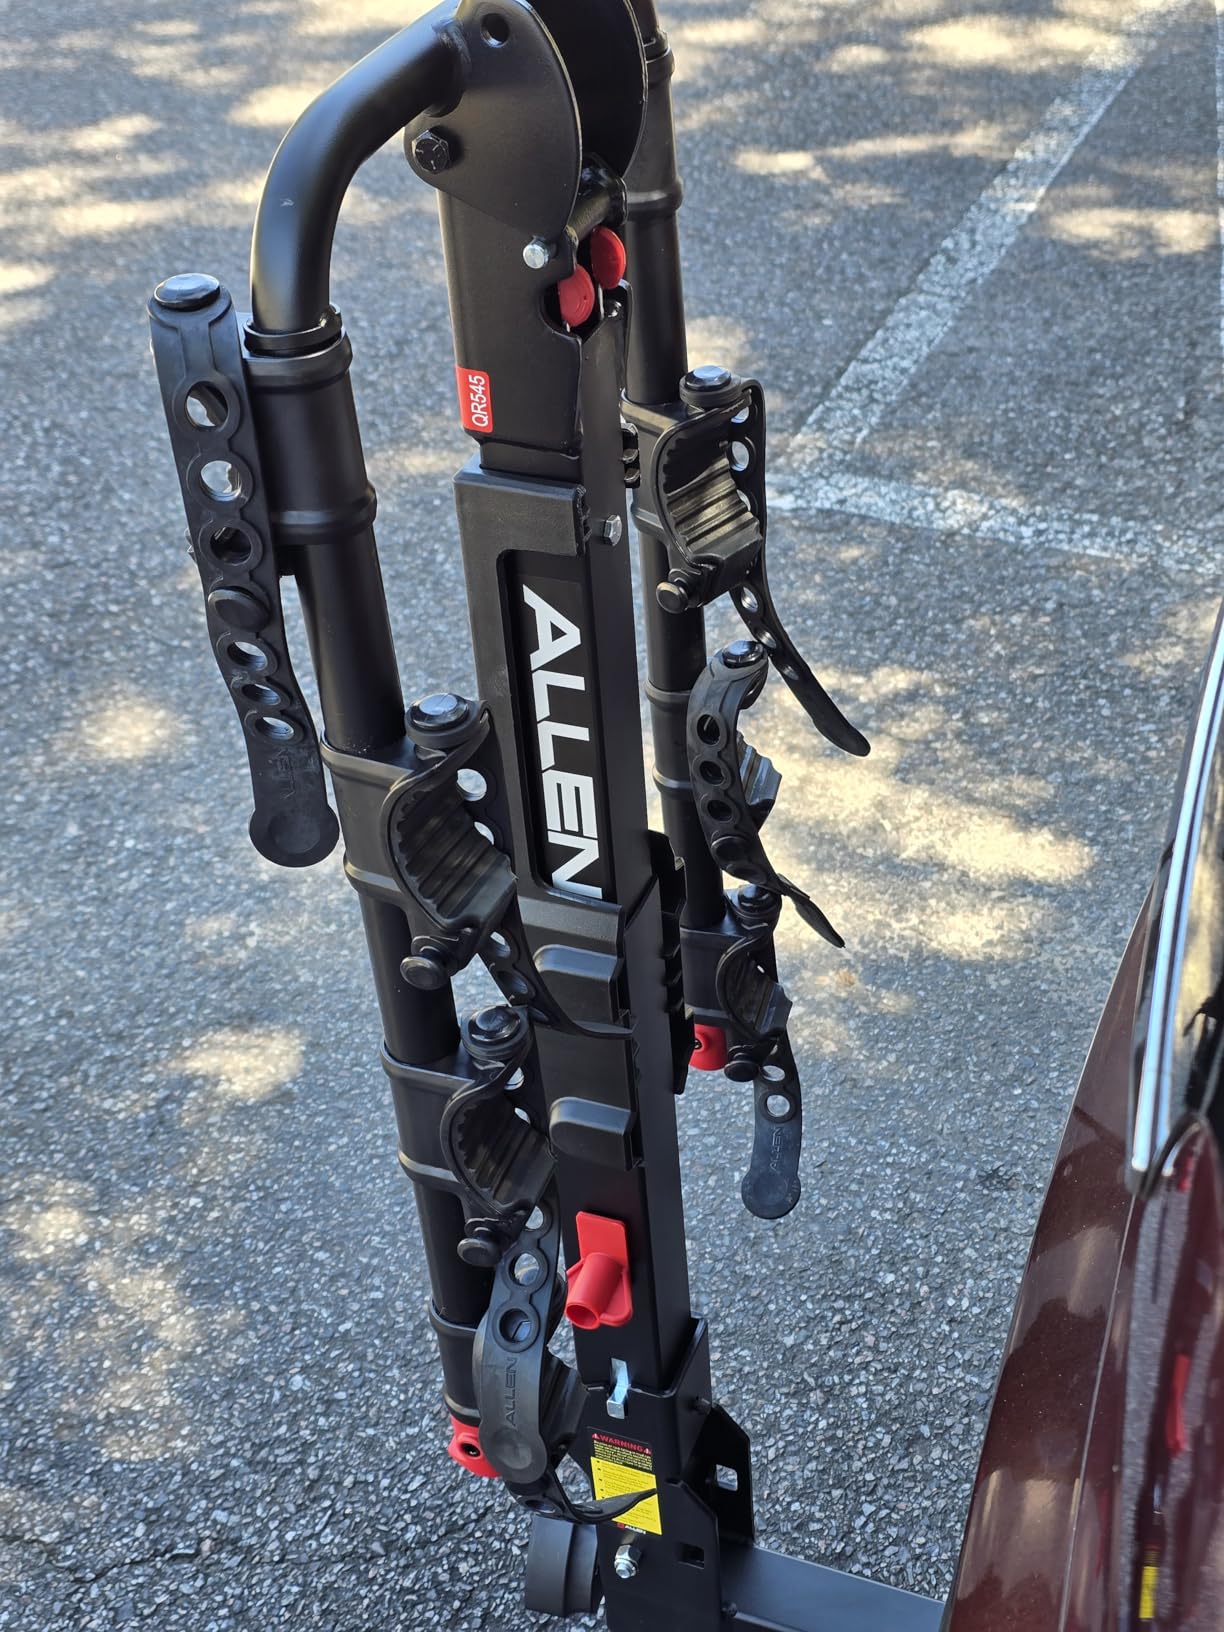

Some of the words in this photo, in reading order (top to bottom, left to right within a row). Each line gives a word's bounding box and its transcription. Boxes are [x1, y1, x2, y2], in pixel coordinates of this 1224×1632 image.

[468, 374, 489, 427] QR545
[522, 583, 603, 900] ALLEN
[504, 1356, 518, 1430] ALLEN
[599, 1435, 644, 1452] WARNING
